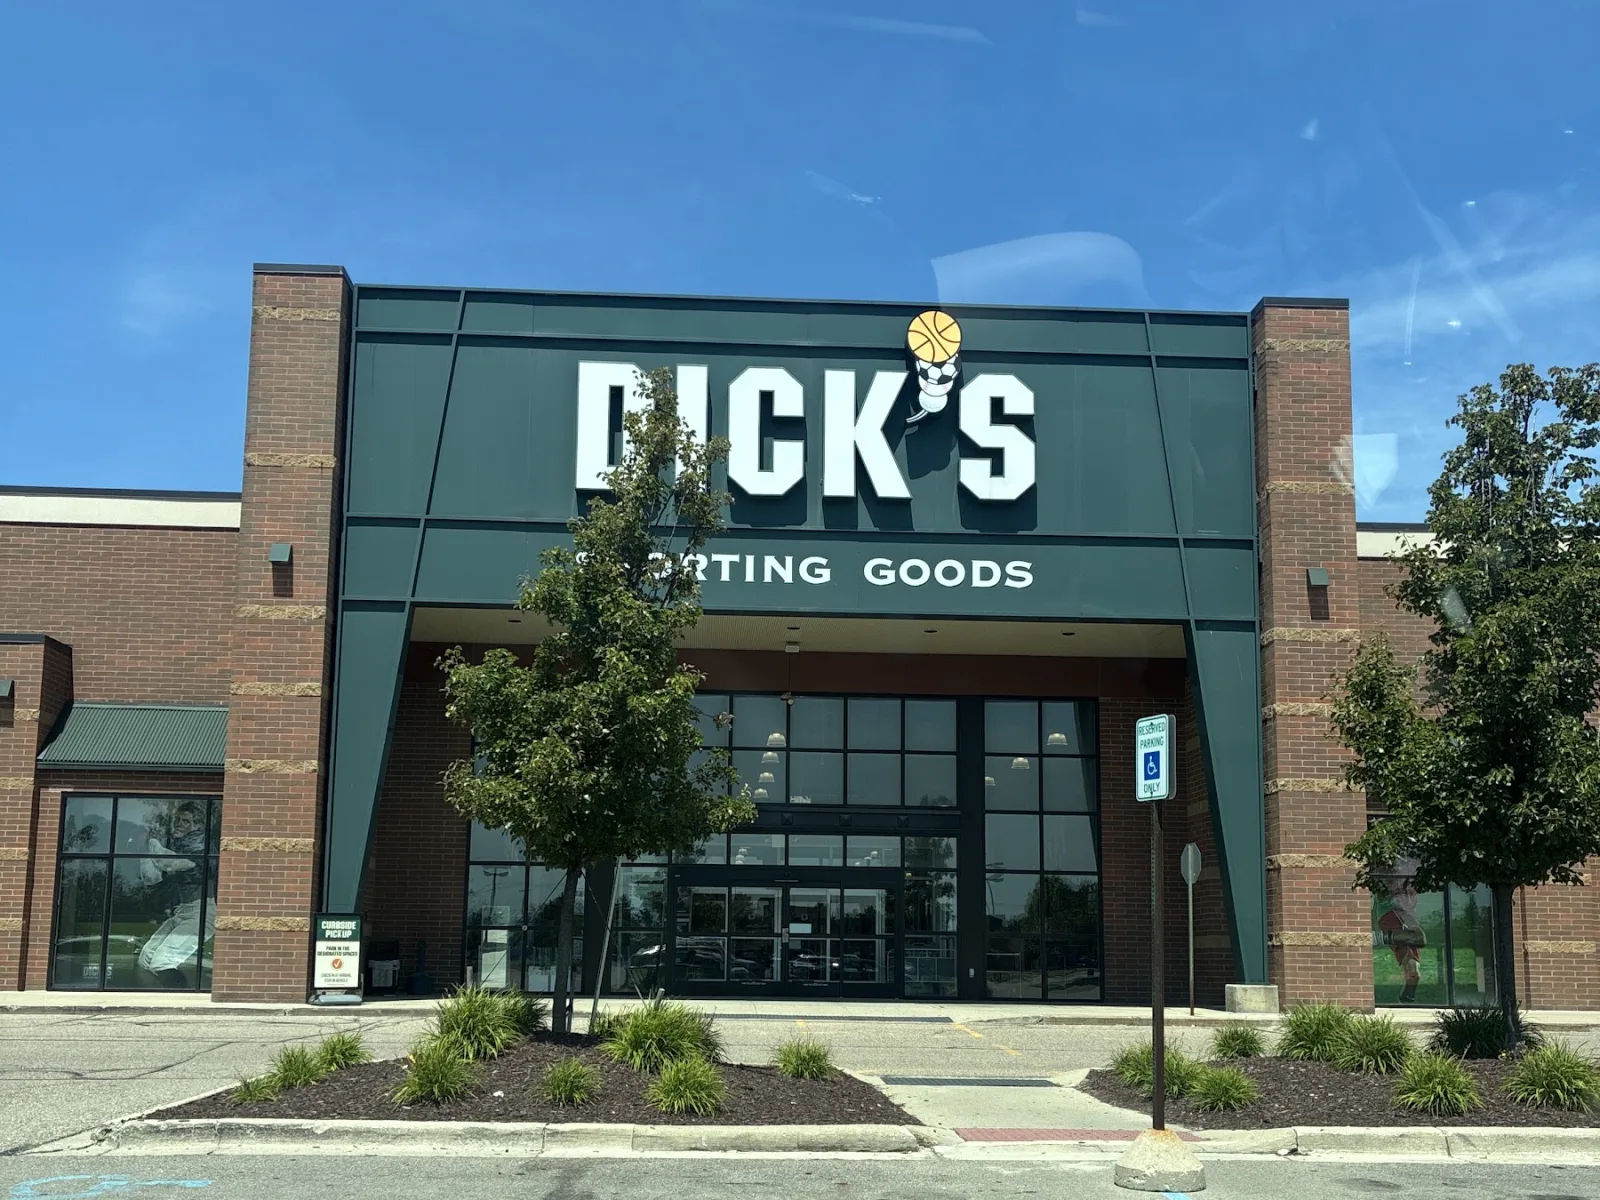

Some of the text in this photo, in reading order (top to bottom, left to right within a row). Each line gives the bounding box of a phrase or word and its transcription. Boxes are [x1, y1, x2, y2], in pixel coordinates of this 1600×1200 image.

[575, 310, 1036, 501] DICK'S
[863, 558, 1034, 589] GOODS
[1138, 721, 1166, 736] RESERVED
[1140, 736, 1164, 750] PARKING
[1143, 781, 1161, 793] ONLY
[322, 921, 356, 930] CURBSIDE
